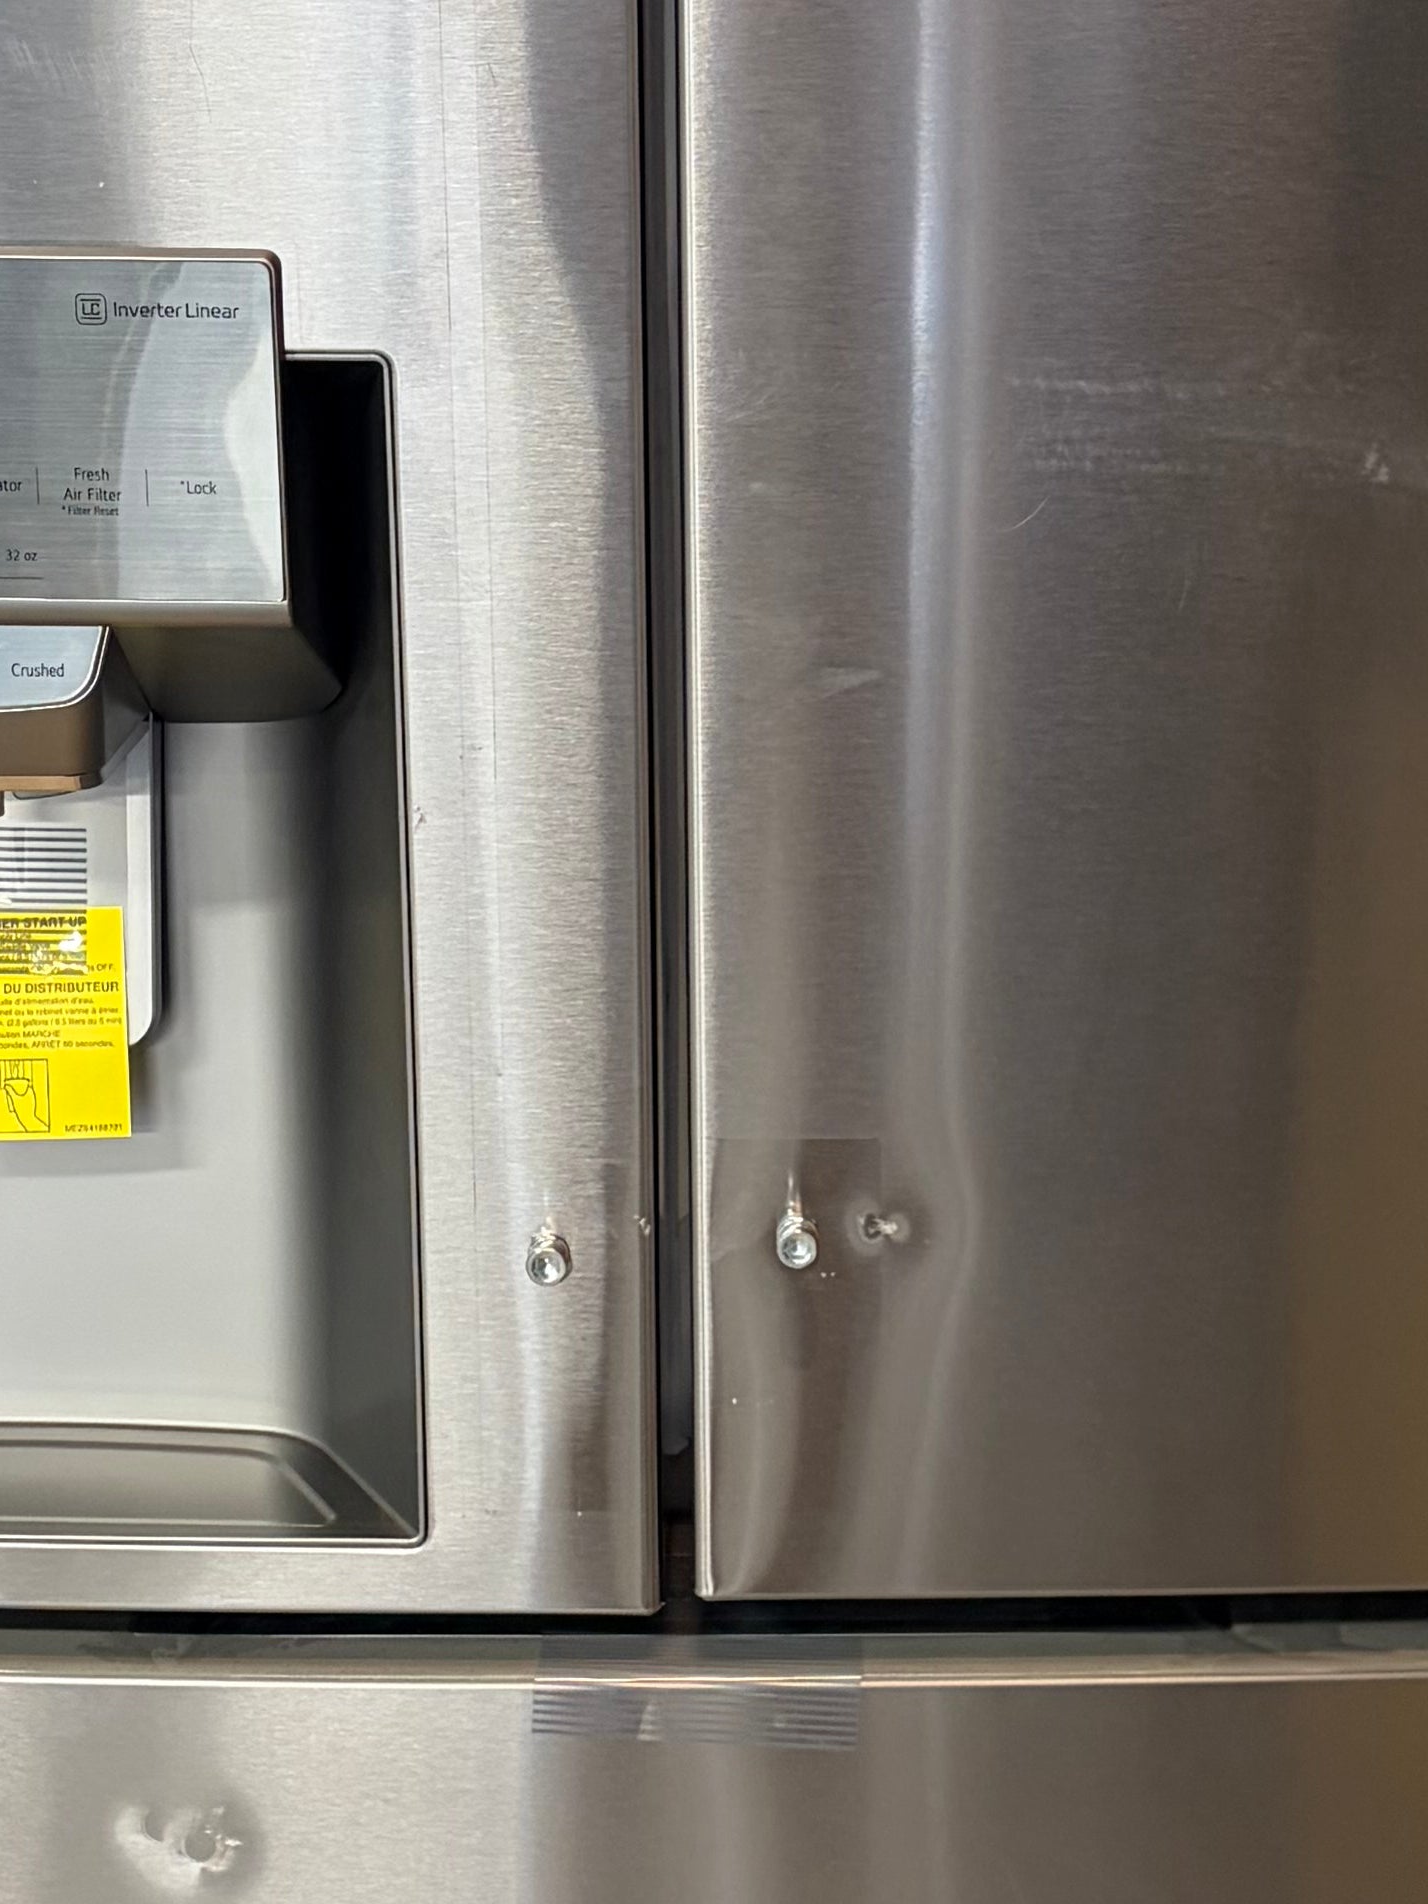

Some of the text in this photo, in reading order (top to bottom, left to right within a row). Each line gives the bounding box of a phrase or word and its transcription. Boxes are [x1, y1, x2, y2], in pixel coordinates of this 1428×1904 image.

[113, 301, 182, 318] Inverter
[185, 302, 239, 319] Linear
[73, 467, 110, 481] Fresh
[63, 487, 121, 502] Air Filter
[6, 549, 38, 561] 32 oz
[11, 662, 65, 678] Crushed
[3, 982, 21, 995] DU
[25, 981, 119, 994] DISTRIBUTEUR
